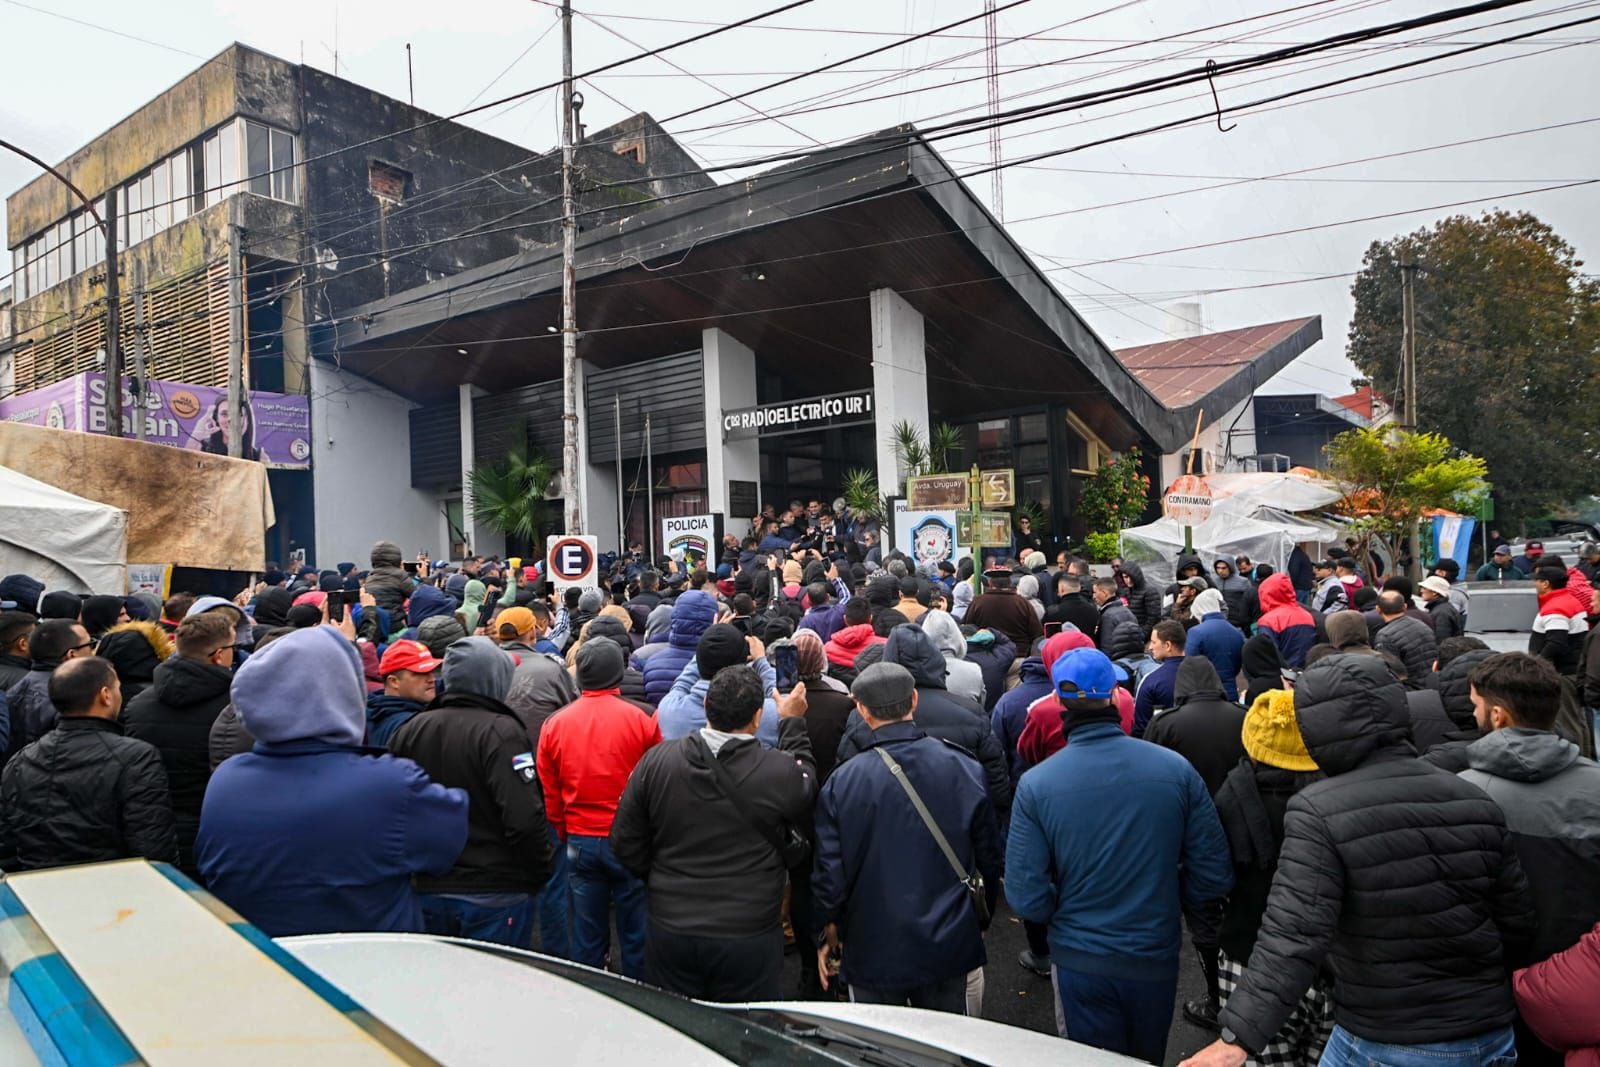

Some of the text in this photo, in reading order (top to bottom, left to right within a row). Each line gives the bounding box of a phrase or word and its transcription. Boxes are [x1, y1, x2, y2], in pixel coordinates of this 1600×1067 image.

[741, 398, 843, 429] RADIOELECTRICO
[845, 396, 863, 414] UR
[866, 394, 872, 412] I
[933, 480, 962, 489] Uruguay
[1168, 495, 1211, 506] CONTRAMANO
[667, 518, 709, 531] POLICIA
[562, 545, 582, 575] E
